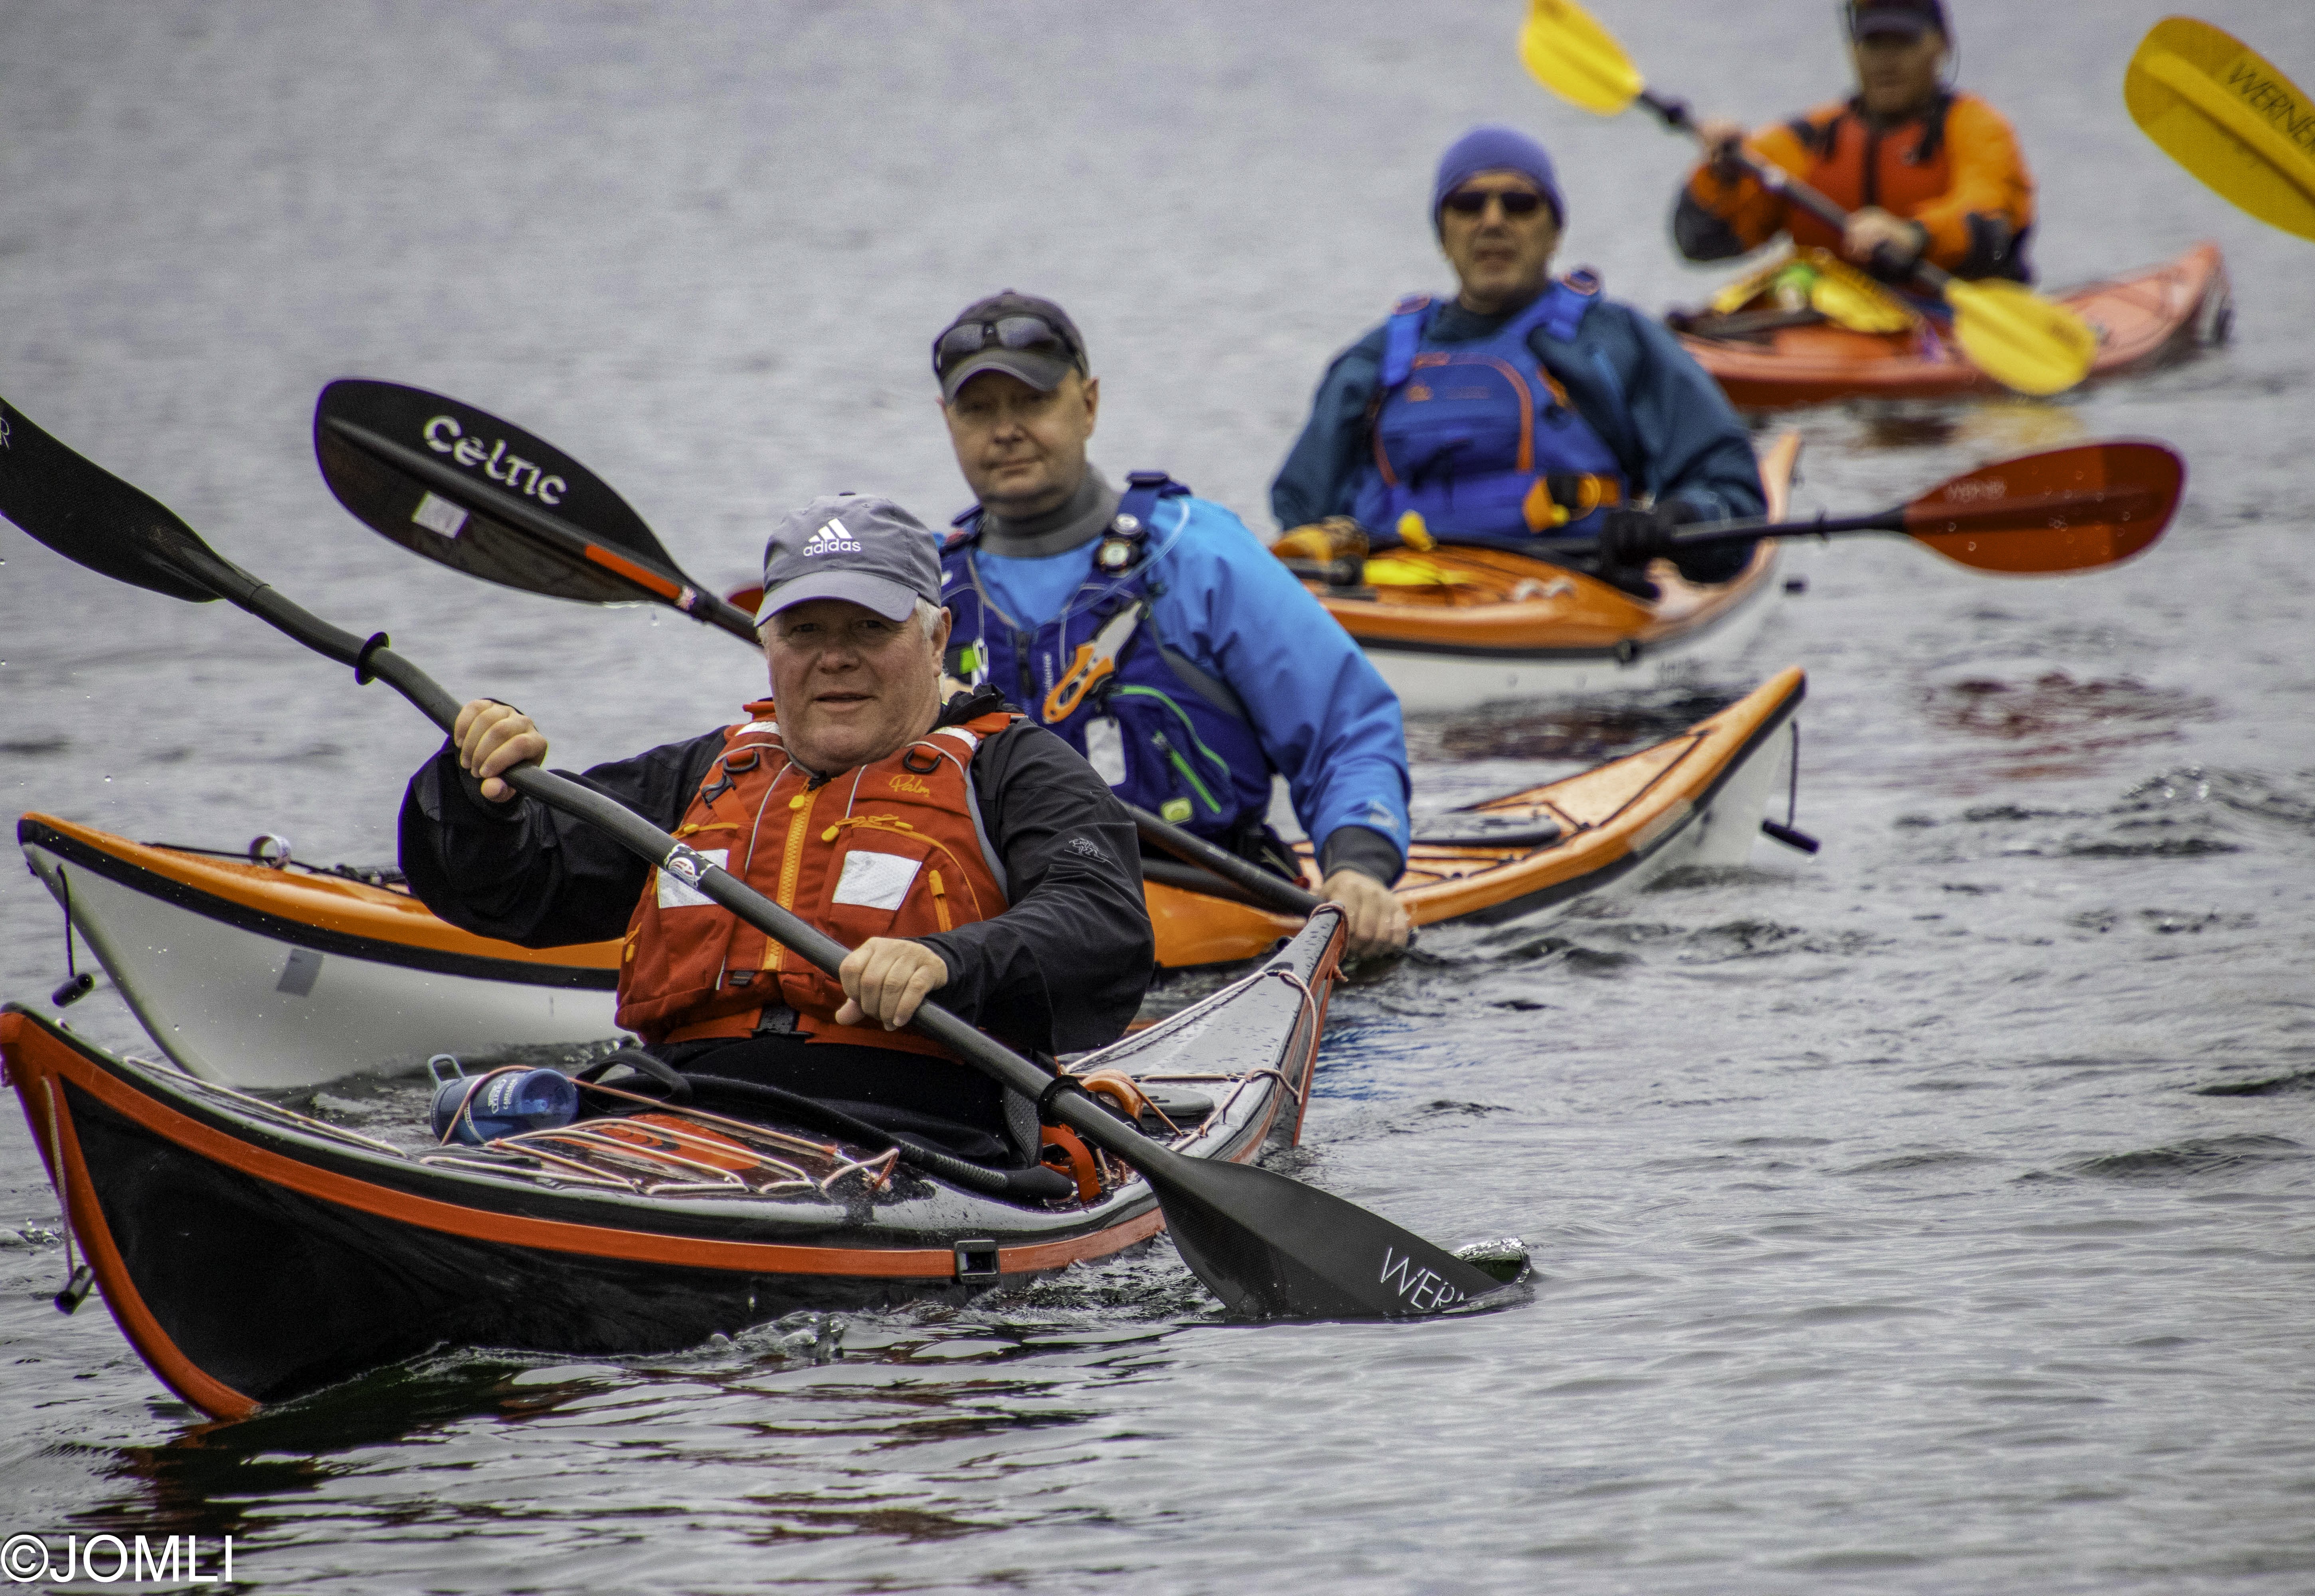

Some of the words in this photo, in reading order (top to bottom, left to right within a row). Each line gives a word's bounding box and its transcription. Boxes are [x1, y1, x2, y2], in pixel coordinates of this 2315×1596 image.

[2228, 62, 2315, 152] WERNE
[803, 538, 861, 557] adidas
[889, 774, 930, 796] Palm
[1380, 1247, 1464, 1309] WER
